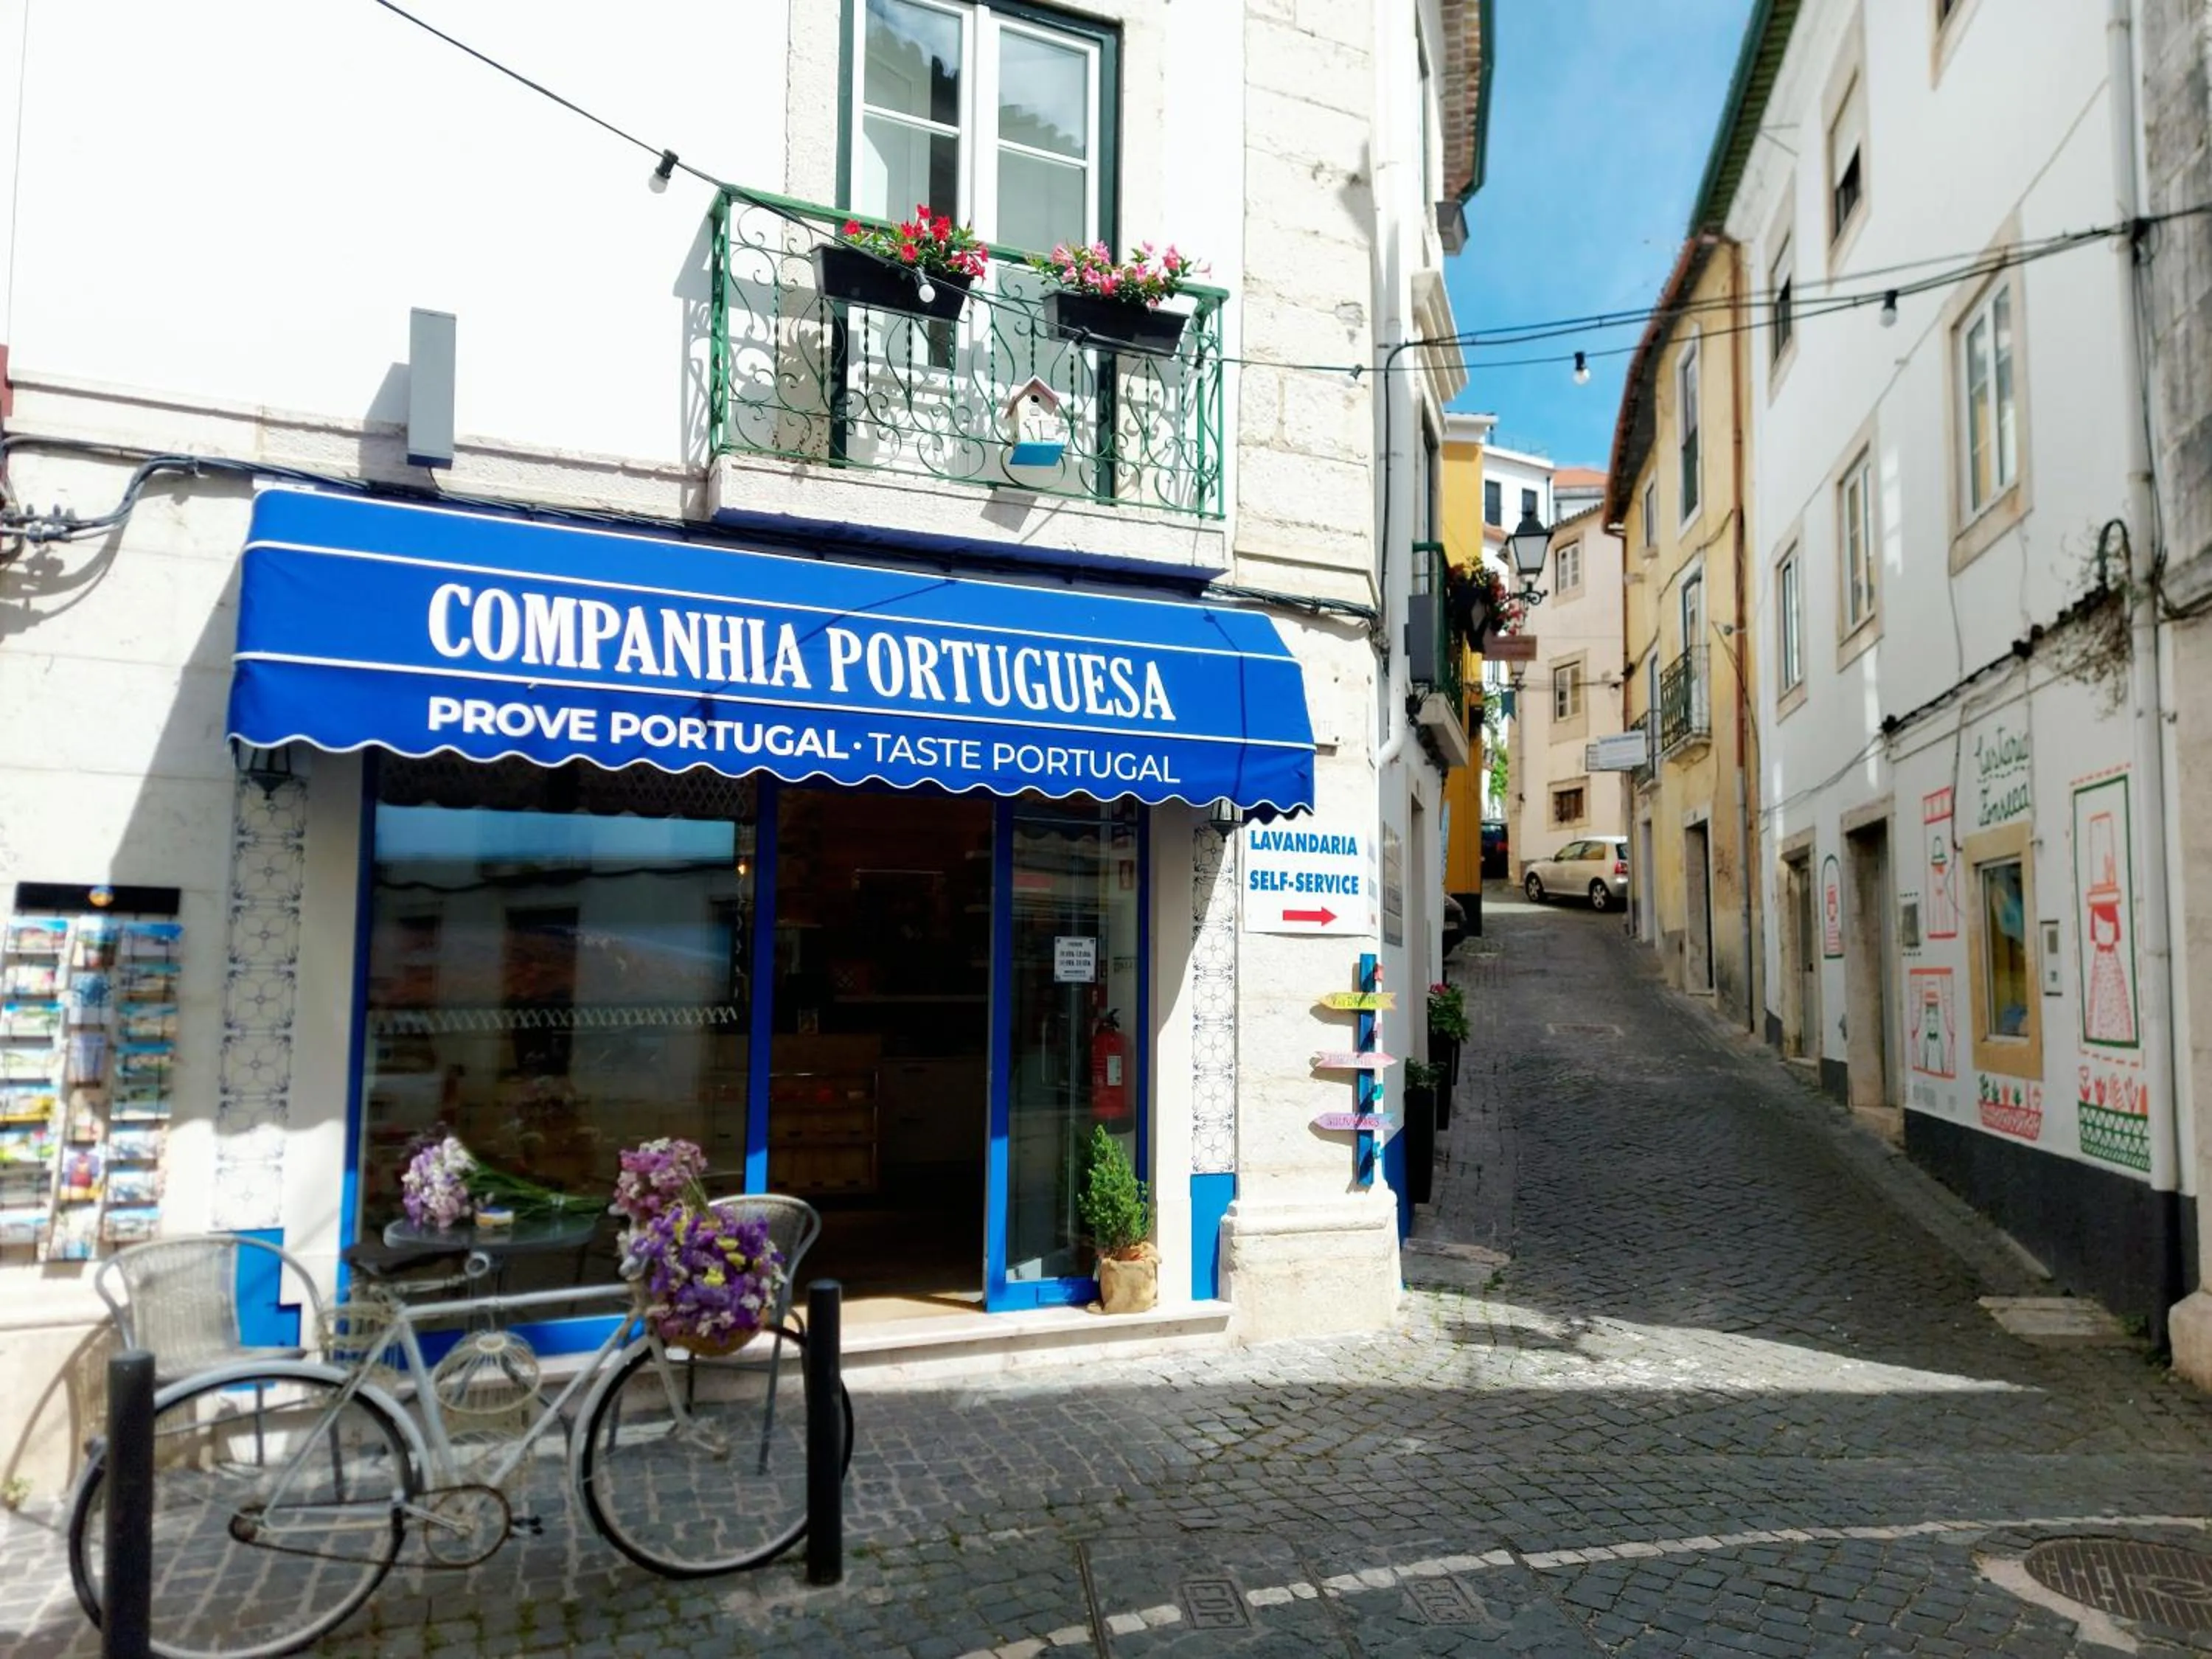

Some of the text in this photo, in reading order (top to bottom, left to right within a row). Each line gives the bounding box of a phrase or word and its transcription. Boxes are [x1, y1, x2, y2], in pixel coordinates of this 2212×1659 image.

[428, 583, 1176, 721] COMPANHIA PORTUGUESA
[428, 696, 597, 742] PROVE
[868, 732, 981, 769] TASTE
[993, 742, 1180, 783] PORTUGAL
[1249, 830, 1358, 856] LAVANDARIA
[1249, 869, 1359, 895] SELF-SERVICE
[1189, 1585, 1237, 1624] EDP
